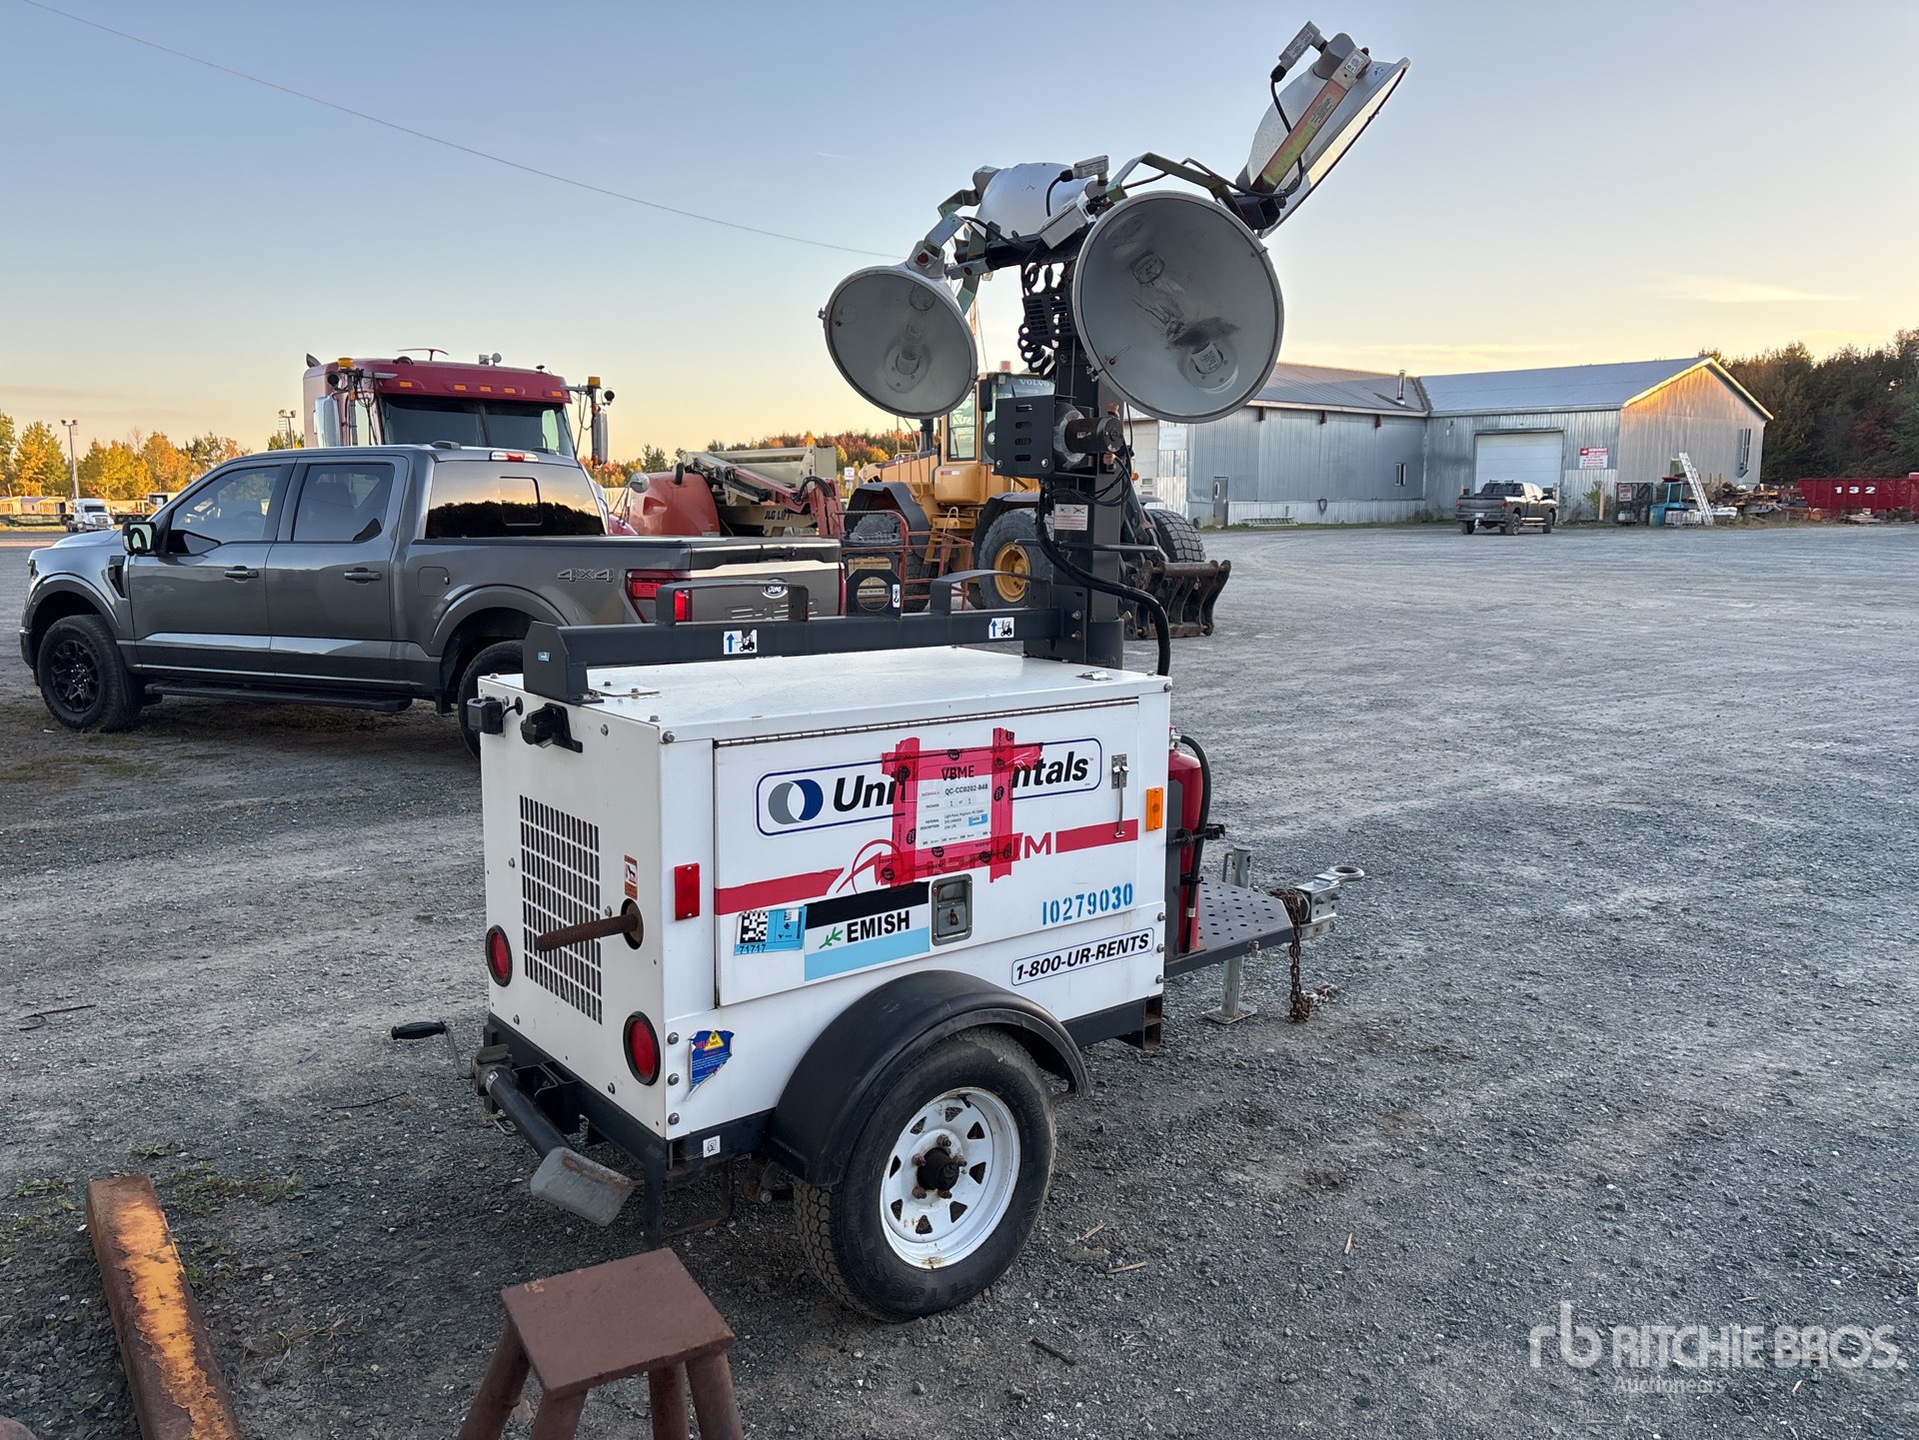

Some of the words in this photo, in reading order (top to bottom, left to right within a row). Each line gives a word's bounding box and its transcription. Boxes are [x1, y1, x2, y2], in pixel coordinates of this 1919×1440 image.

[1019, 379, 1050, 387] VOLVO
[833, 774, 905, 812] Uni
[1012, 751, 1088, 788] ntals
[941, 765, 975, 781] VBME
[846, 910, 910, 943] EMISH
[739, 943, 767, 954] 71717
[1016, 933, 1149, 980] 1-800-UR-RENTS
